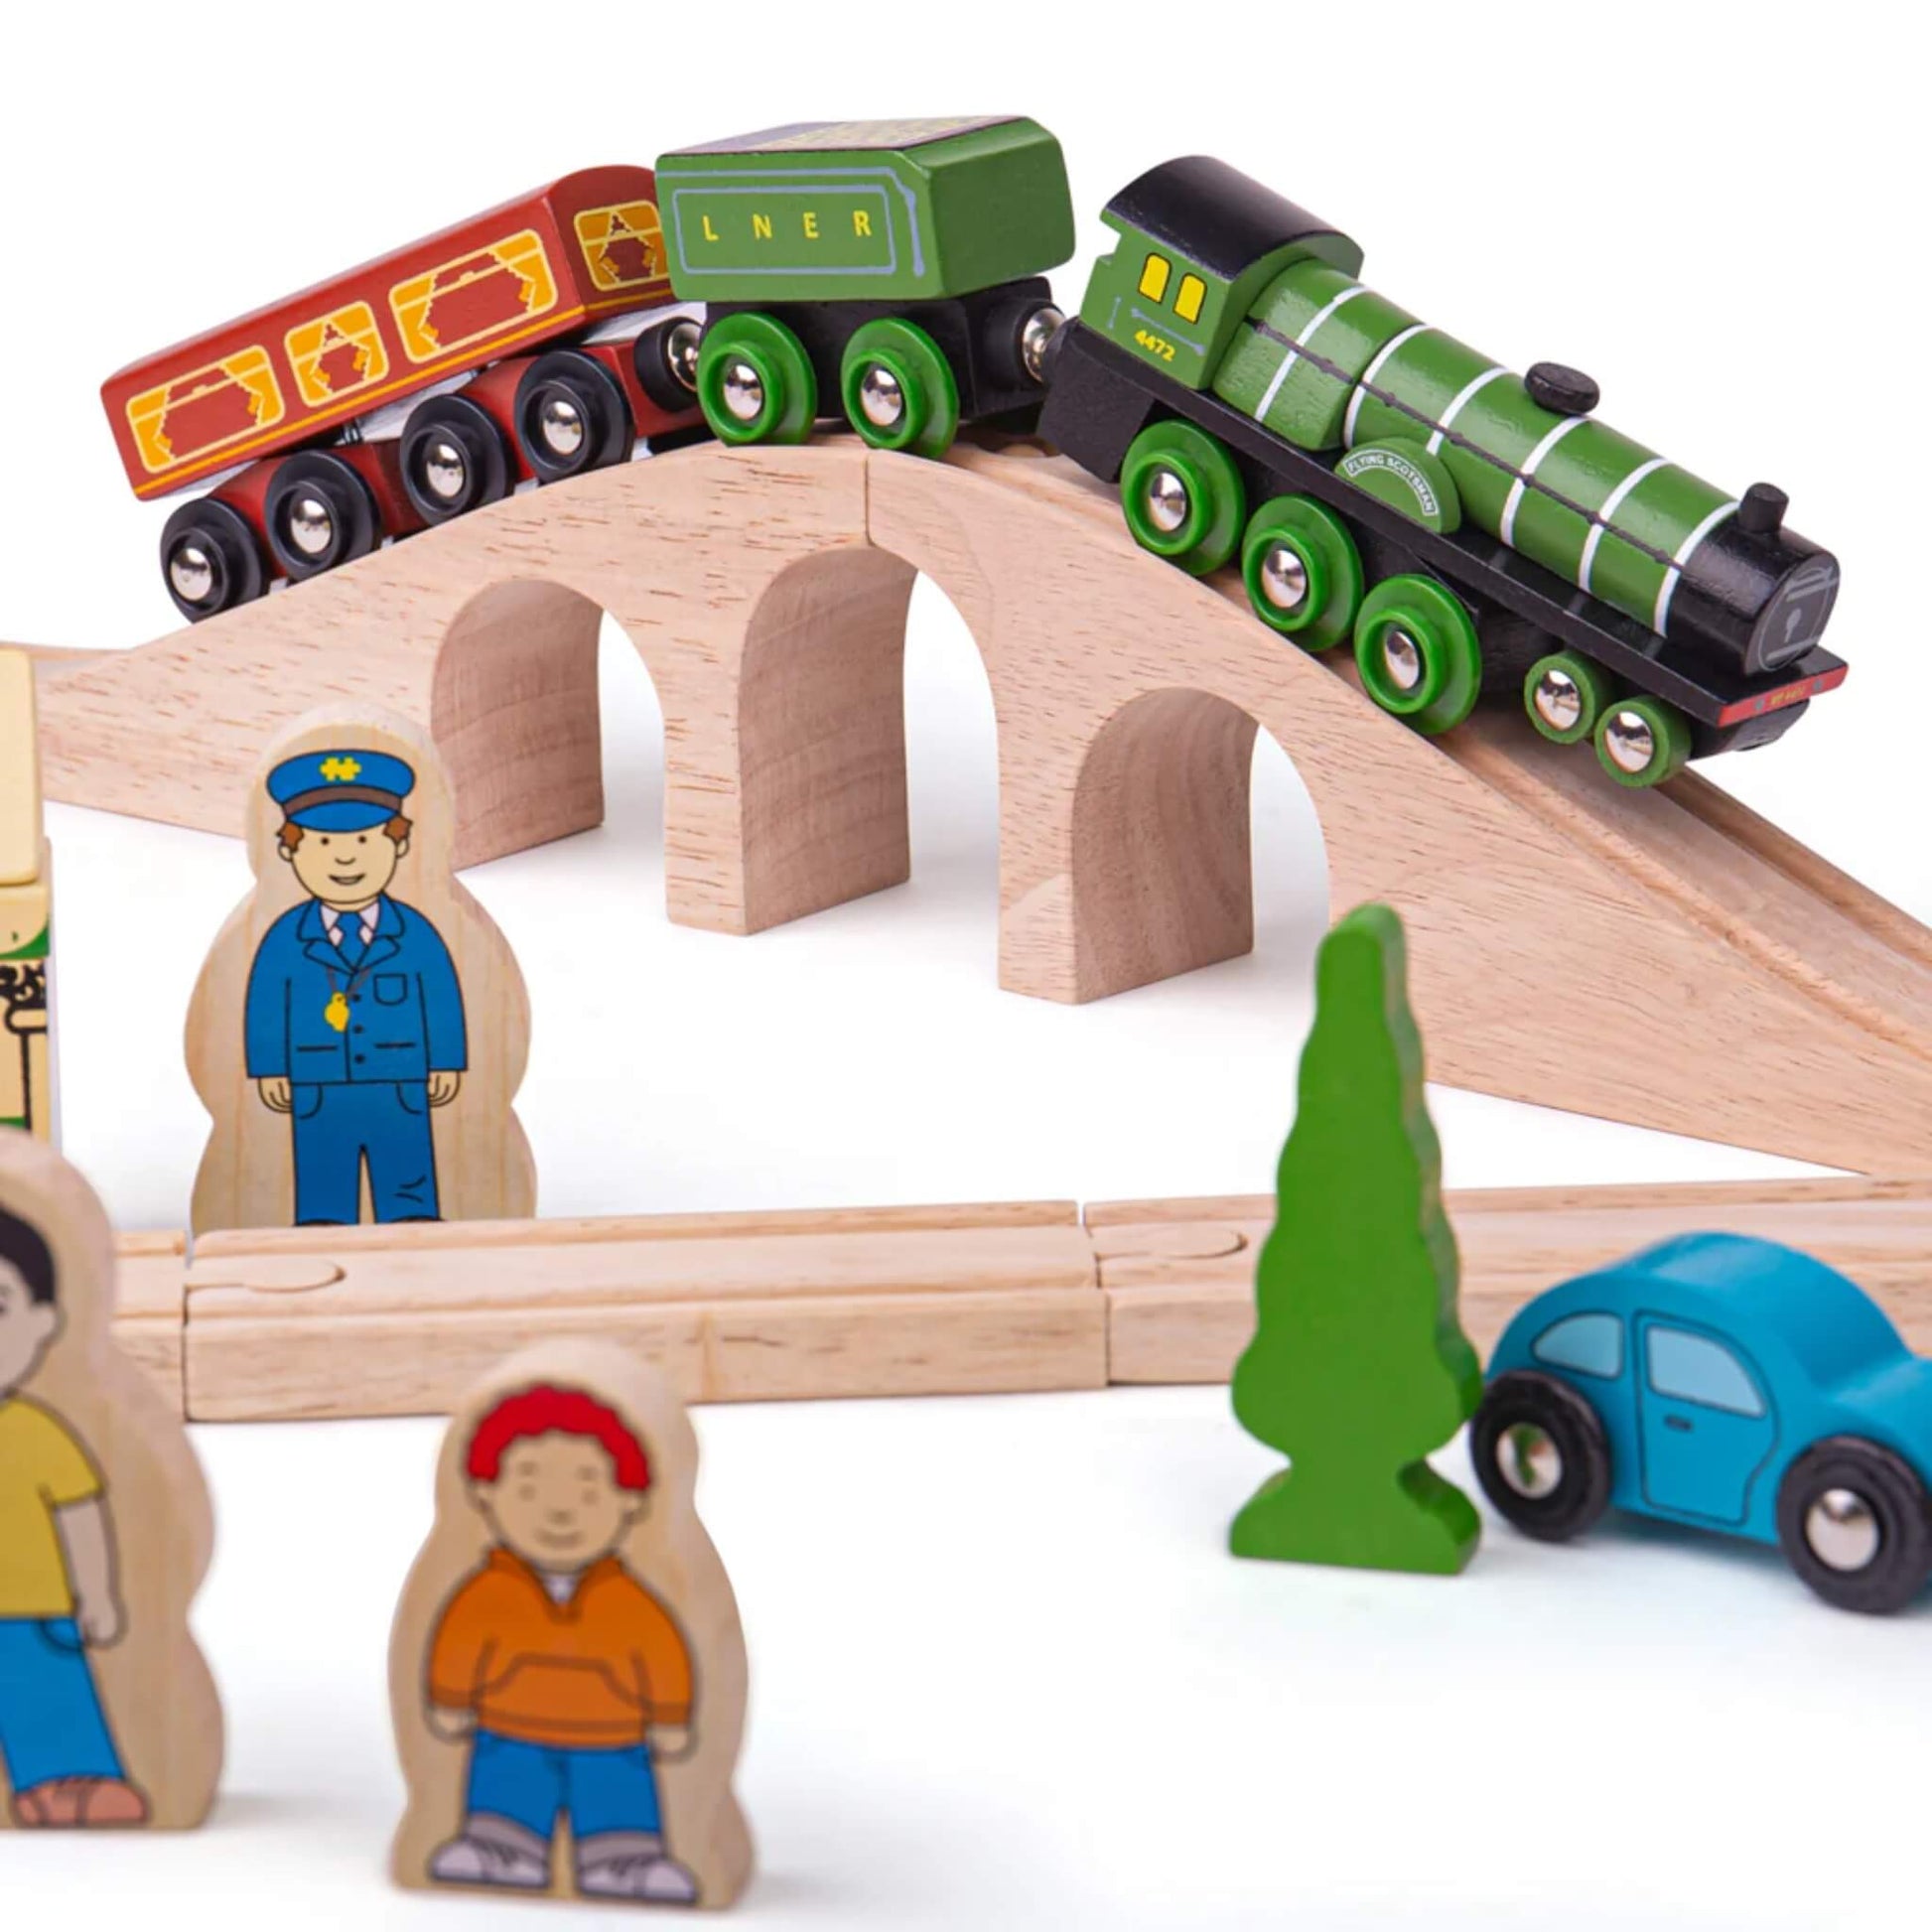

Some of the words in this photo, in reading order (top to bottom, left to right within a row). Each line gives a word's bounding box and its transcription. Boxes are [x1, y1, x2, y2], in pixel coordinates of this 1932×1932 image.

[1135, 329, 1175, 362] 4472
[1346, 455, 1385, 475] FLYING
[1387, 457, 1435, 511] SCOTSMAN
